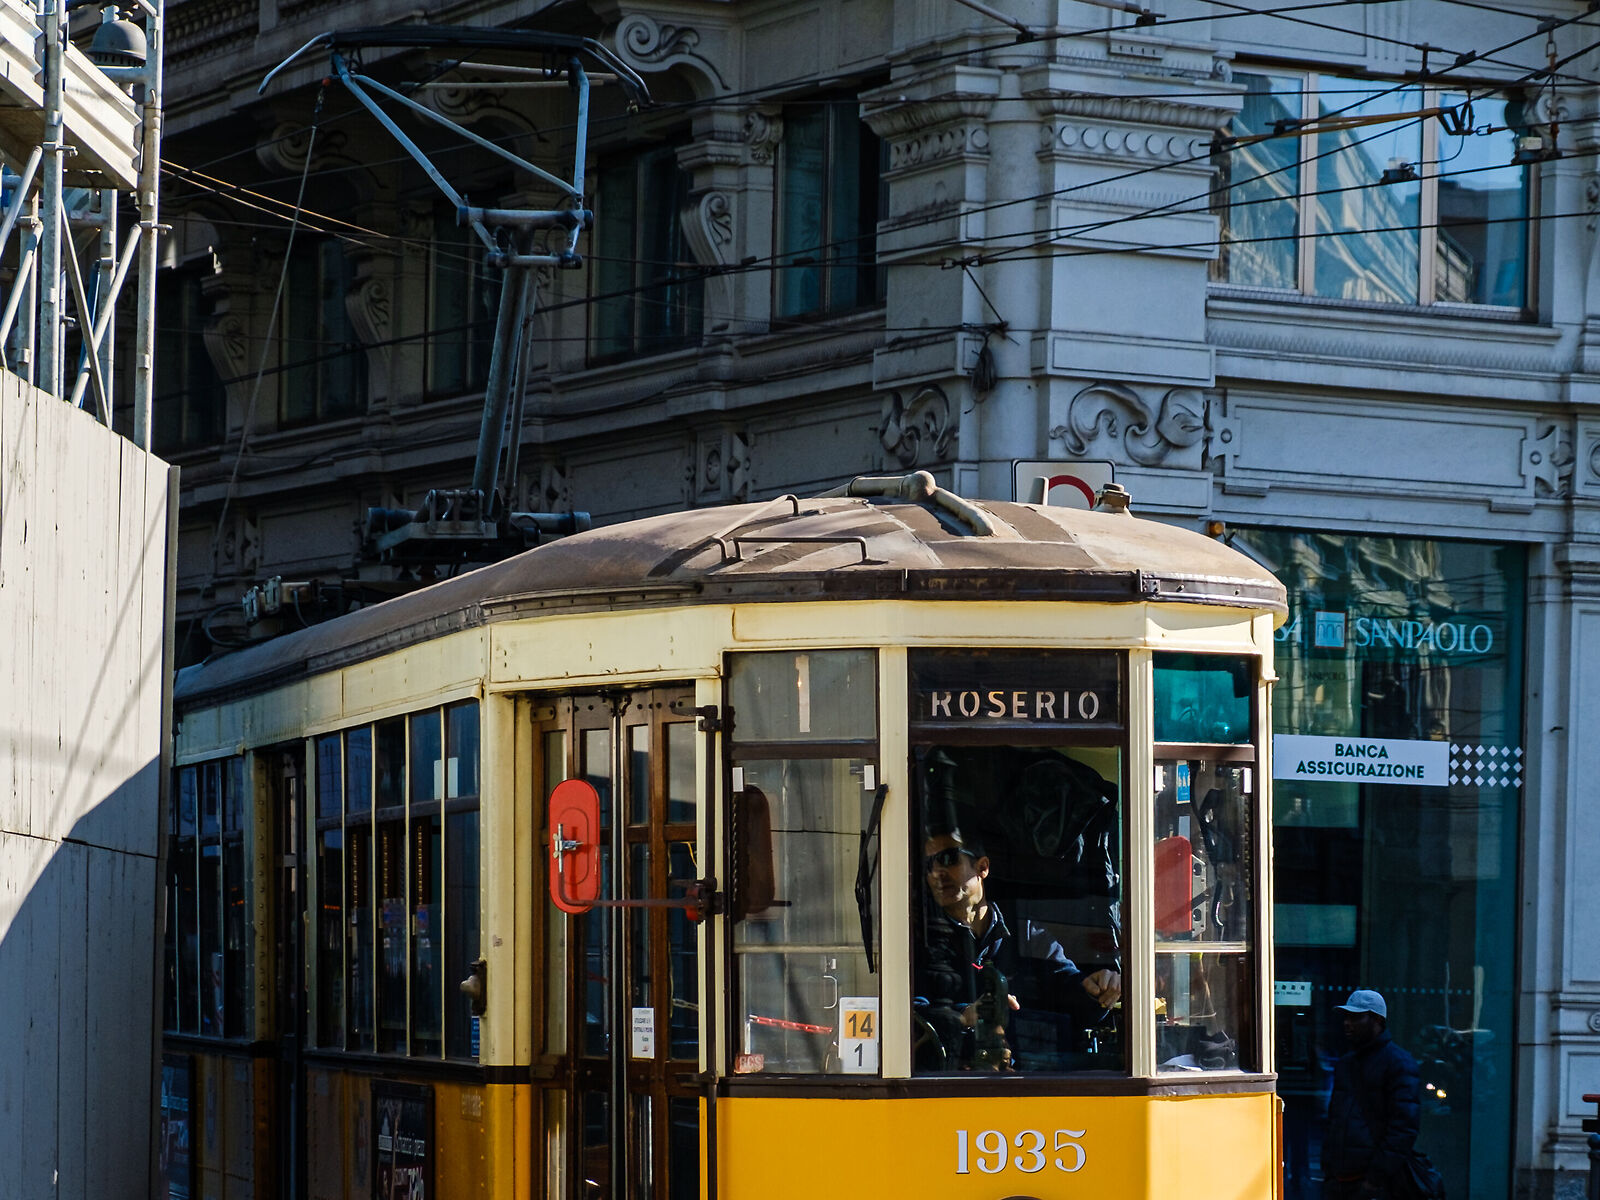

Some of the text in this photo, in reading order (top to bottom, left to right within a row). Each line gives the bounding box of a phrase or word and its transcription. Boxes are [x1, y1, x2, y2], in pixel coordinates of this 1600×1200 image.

[1355, 616, 1494, 654] SANPAOLO
[795, 654, 811, 733] 1
[931, 691, 1100, 720] ROSERIO
[1335, 743, 1389, 759] BANCA
[1296, 760, 1425, 779] ASSICURAZIONE
[847, 1013, 873, 1038] 14
[854, 1043, 863, 1067] 1
[956, 1129, 1087, 1175] 1935
